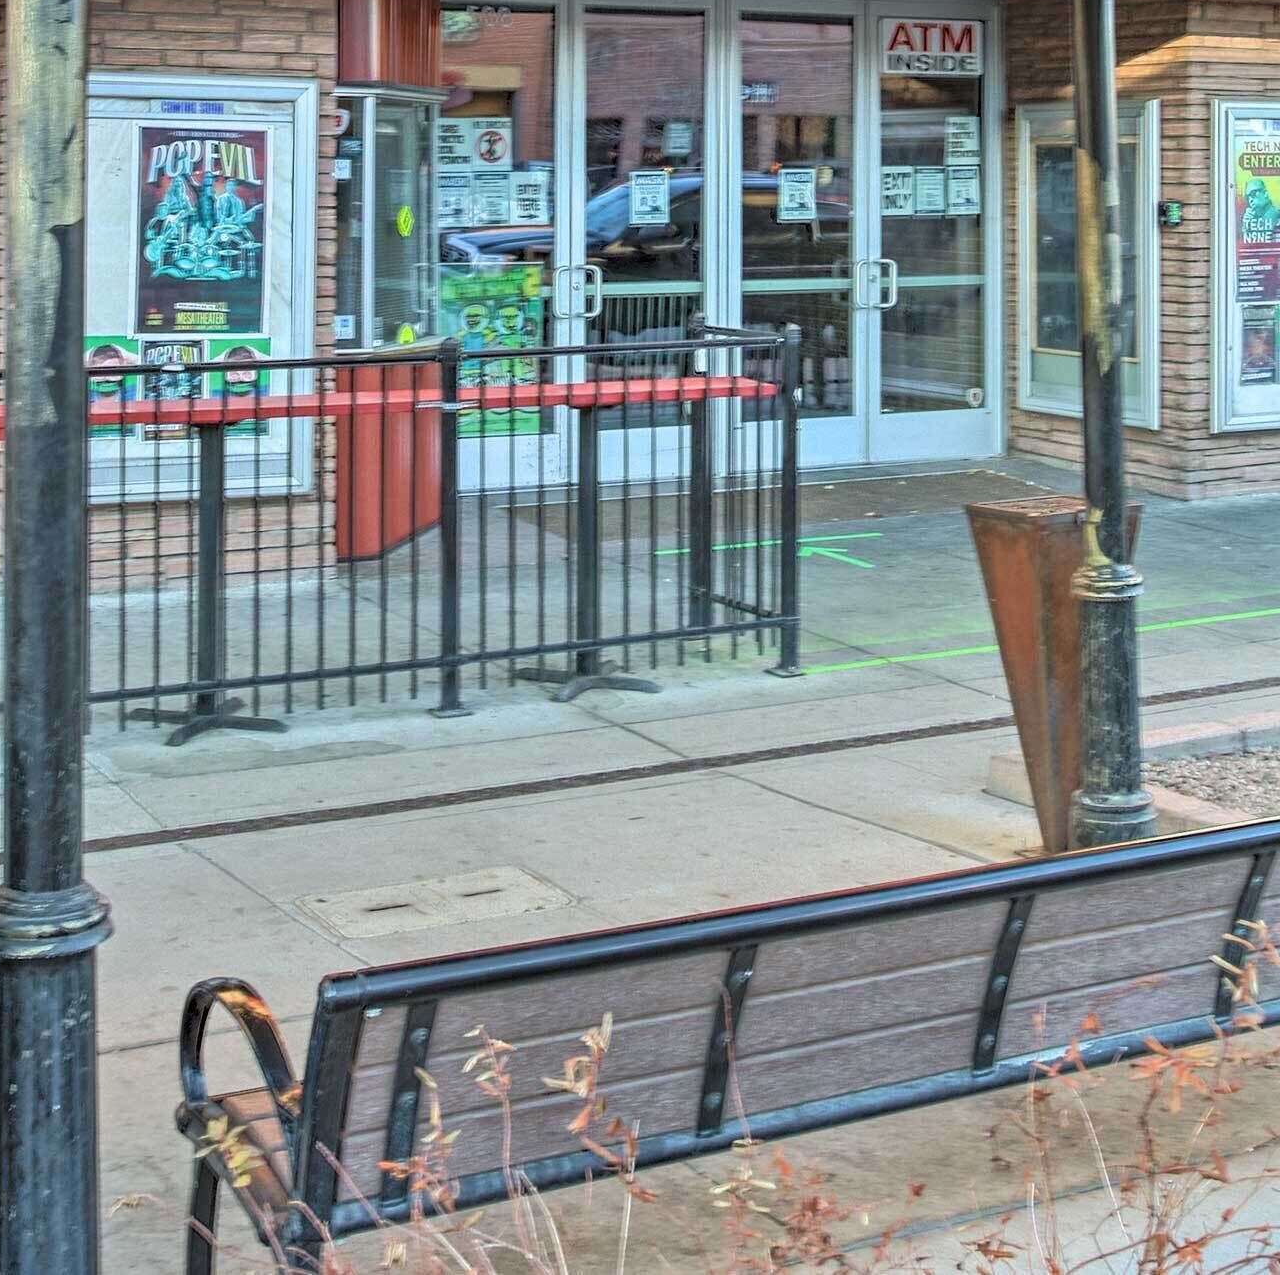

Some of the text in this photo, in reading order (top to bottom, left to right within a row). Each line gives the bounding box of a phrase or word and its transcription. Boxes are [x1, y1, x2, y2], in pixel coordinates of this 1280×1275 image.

[887, 22, 975, 53] ATM
[887, 54, 979, 73] INSIDE
[161, 101, 224, 114] COMING SOON
[1244, 141, 1270, 151] TECH
[146, 140, 264, 186] POP EVIL
[1243, 218, 1272, 231] TECH
[1243, 232, 1272, 243] N9NE
[196, 312, 225, 325] THEATER
